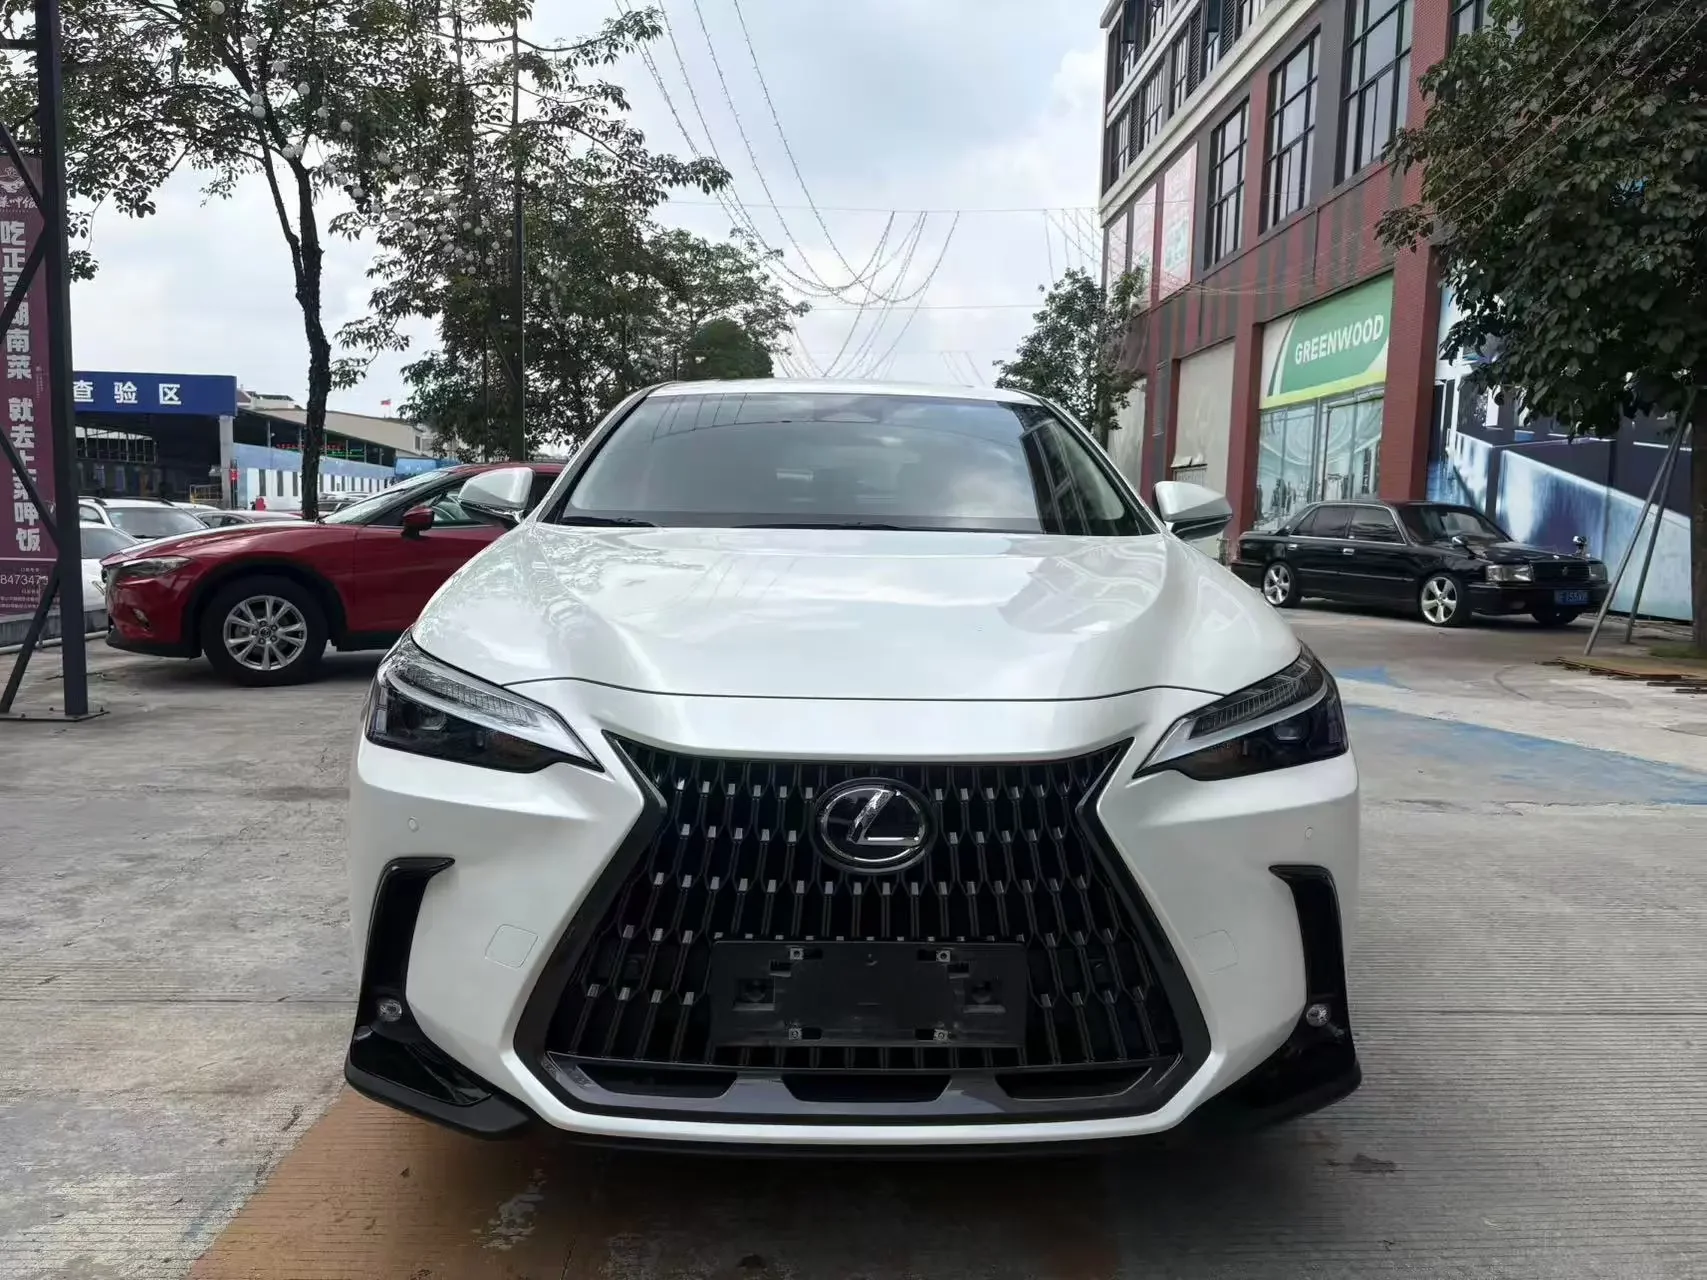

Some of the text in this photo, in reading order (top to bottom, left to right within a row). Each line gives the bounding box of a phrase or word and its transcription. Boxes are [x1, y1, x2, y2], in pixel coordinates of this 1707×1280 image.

[1295, 314, 1384, 365] GREENWOOD
[73, 380, 182, 405] 查验区
